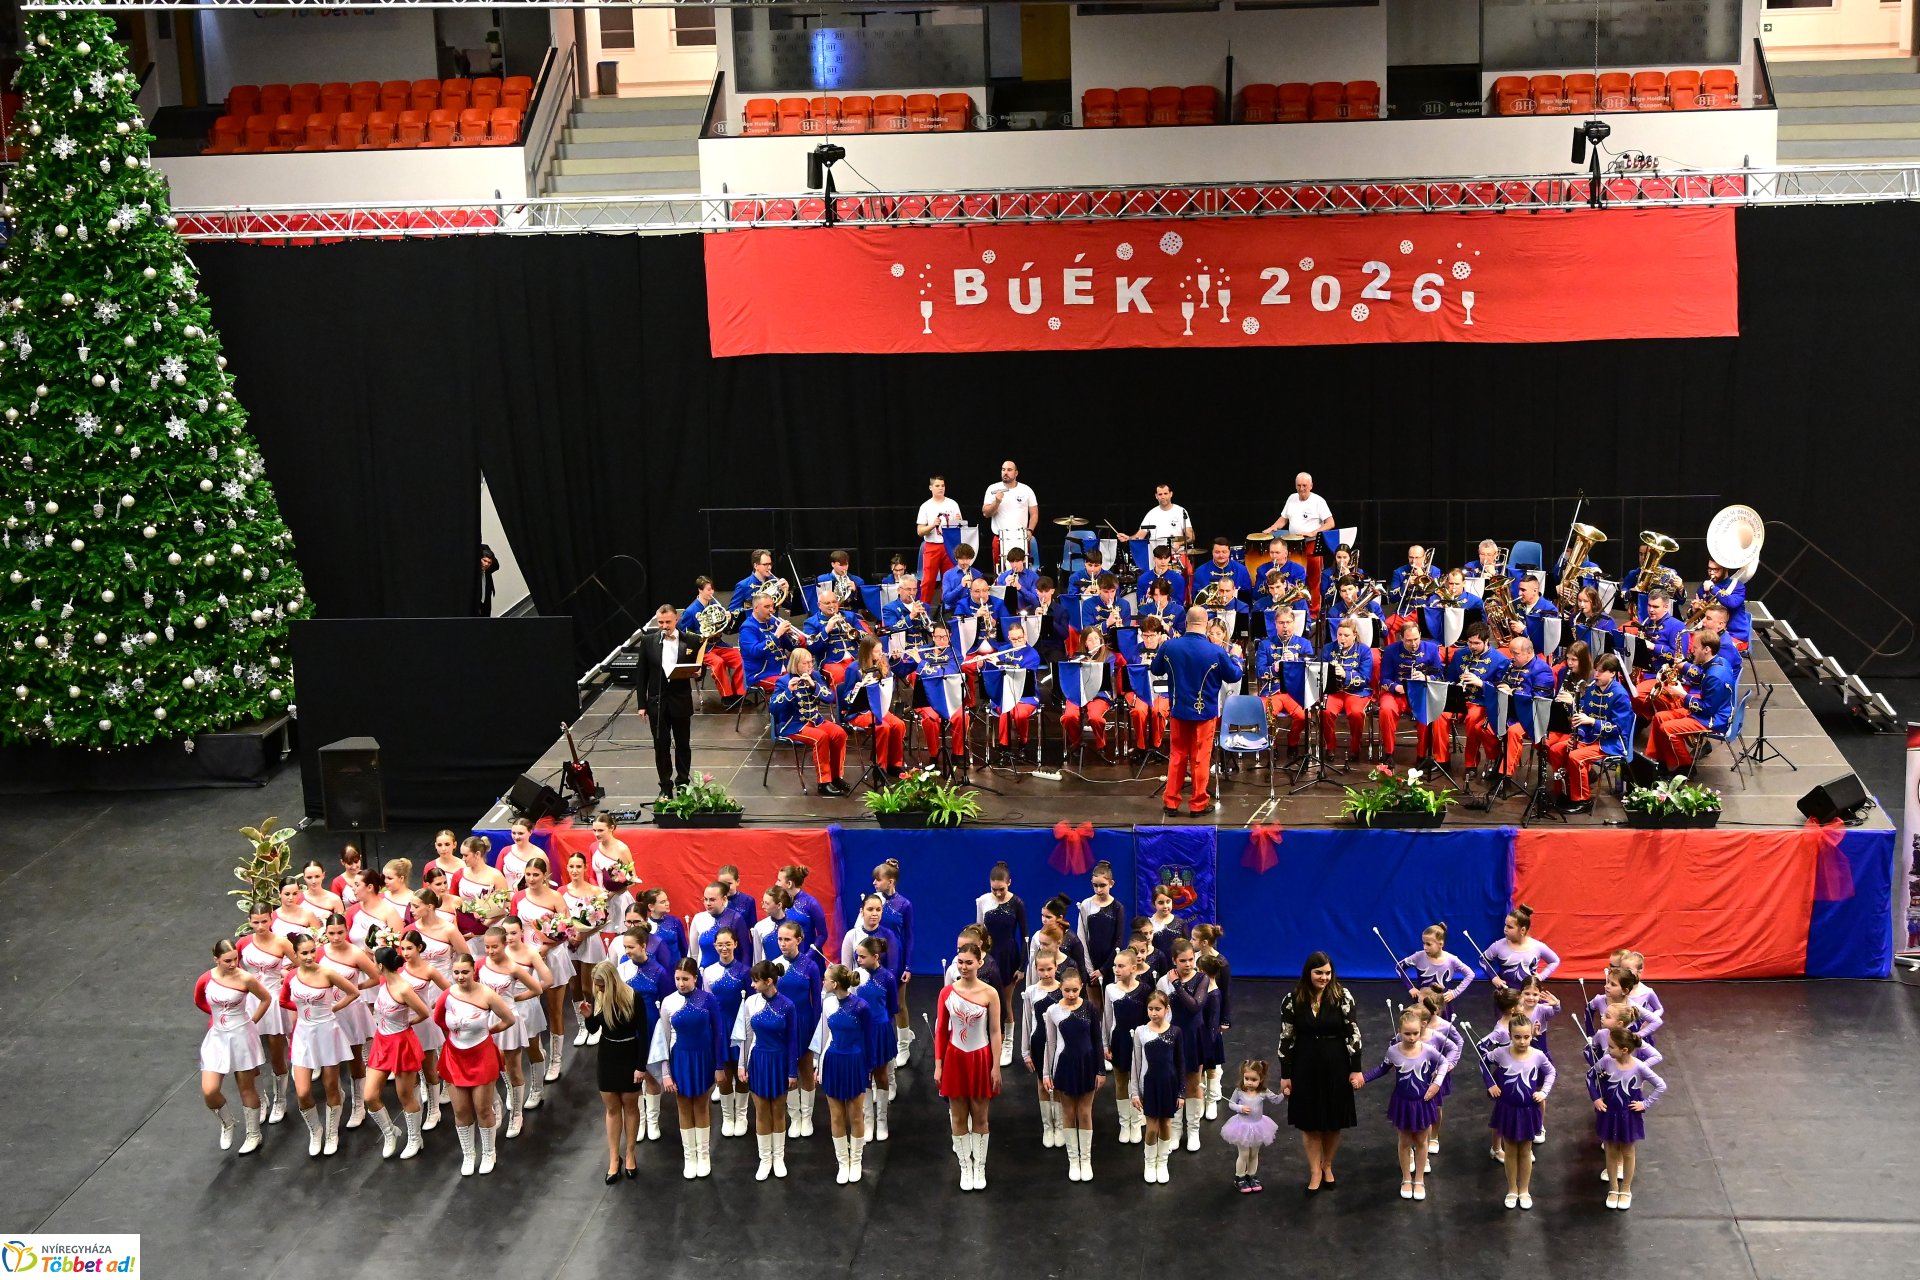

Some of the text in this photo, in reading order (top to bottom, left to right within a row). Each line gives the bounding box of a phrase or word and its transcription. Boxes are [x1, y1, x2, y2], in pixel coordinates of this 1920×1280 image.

[1515, 101, 1534, 111] BH
[1606, 98, 1624, 108] BH
[1699, 96, 1716, 106] BH
[1425, 104, 1442, 113] BH
[802, 121, 819, 131] BH
[889, 120, 905, 129] BH
[953, 253, 1445, 314] BÚÉK 2026
